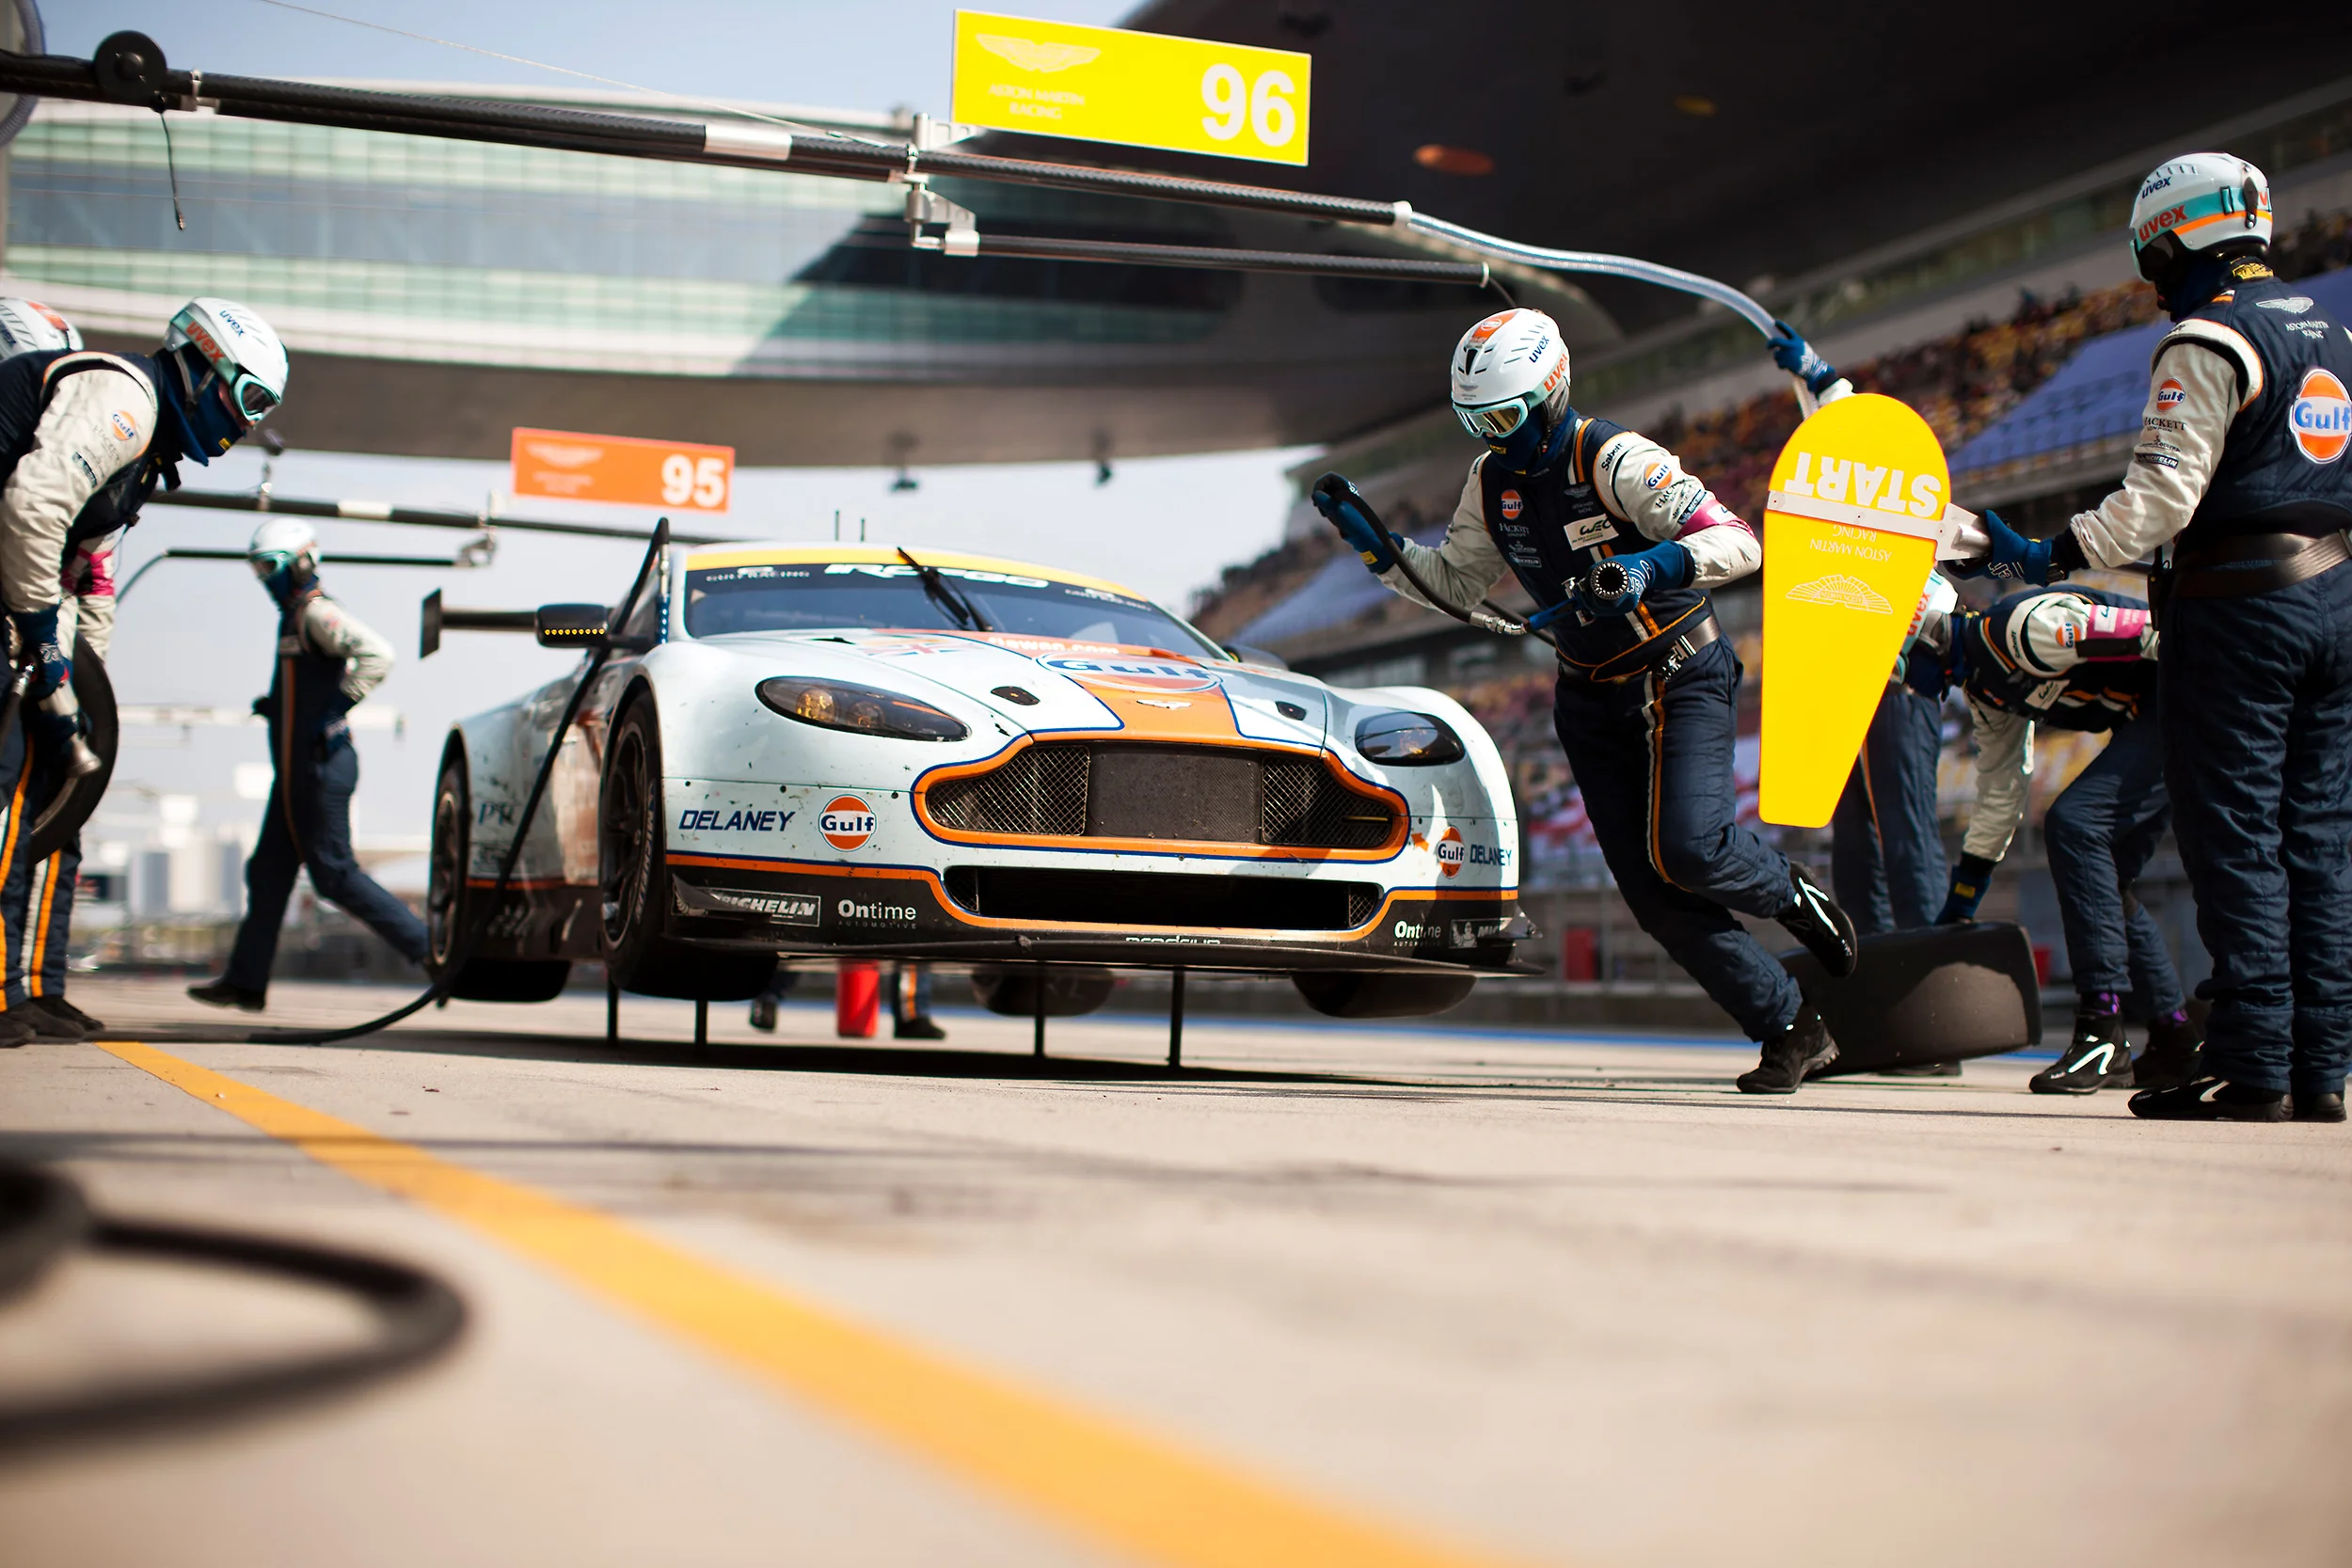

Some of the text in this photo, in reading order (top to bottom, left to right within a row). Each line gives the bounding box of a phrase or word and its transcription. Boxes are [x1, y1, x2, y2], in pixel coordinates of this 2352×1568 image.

[988, 84, 1085, 105] ASTON MARTIN
[1201, 63, 1295, 148] 96
[1009, 102, 1062, 119] RACING
[2141, 176, 2171, 198] uvex
[2138, 204, 2188, 242] uvex
[219, 309, 245, 337] uvex
[185, 321, 225, 366] uvex
[1528, 335, 1549, 363] uvex
[2158, 390, 2185, 402] Gulf
[113, 413, 135, 438] Gulf
[2295, 401, 2351, 431] Gulf
[1601, 442, 1624, 471] Sabelt
[661, 453, 724, 508] 95
[1647, 464, 1671, 488] Gulf
[1784, 451, 1942, 518] START
[1502, 499, 1522, 511] Gulf
[1580, 518, 1612, 535] WEC
[1833, 524, 1877, 542] RACING
[1809, 538, 1893, 562] ASTON MARTIN
[1907, 594, 1931, 636] uvex
[2065, 622, 2074, 648] Gulf
[1046, 658, 1211, 679] Gulf
[678, 809, 796, 832] DELANEY
[820, 814, 874, 832] Gulf
[1438, 843, 1465, 861] Gulf
[1470, 844, 1513, 866] DELANEY
[838, 899, 916, 920] Ontime
[837, 921, 917, 929] AUTOMOTIVE
